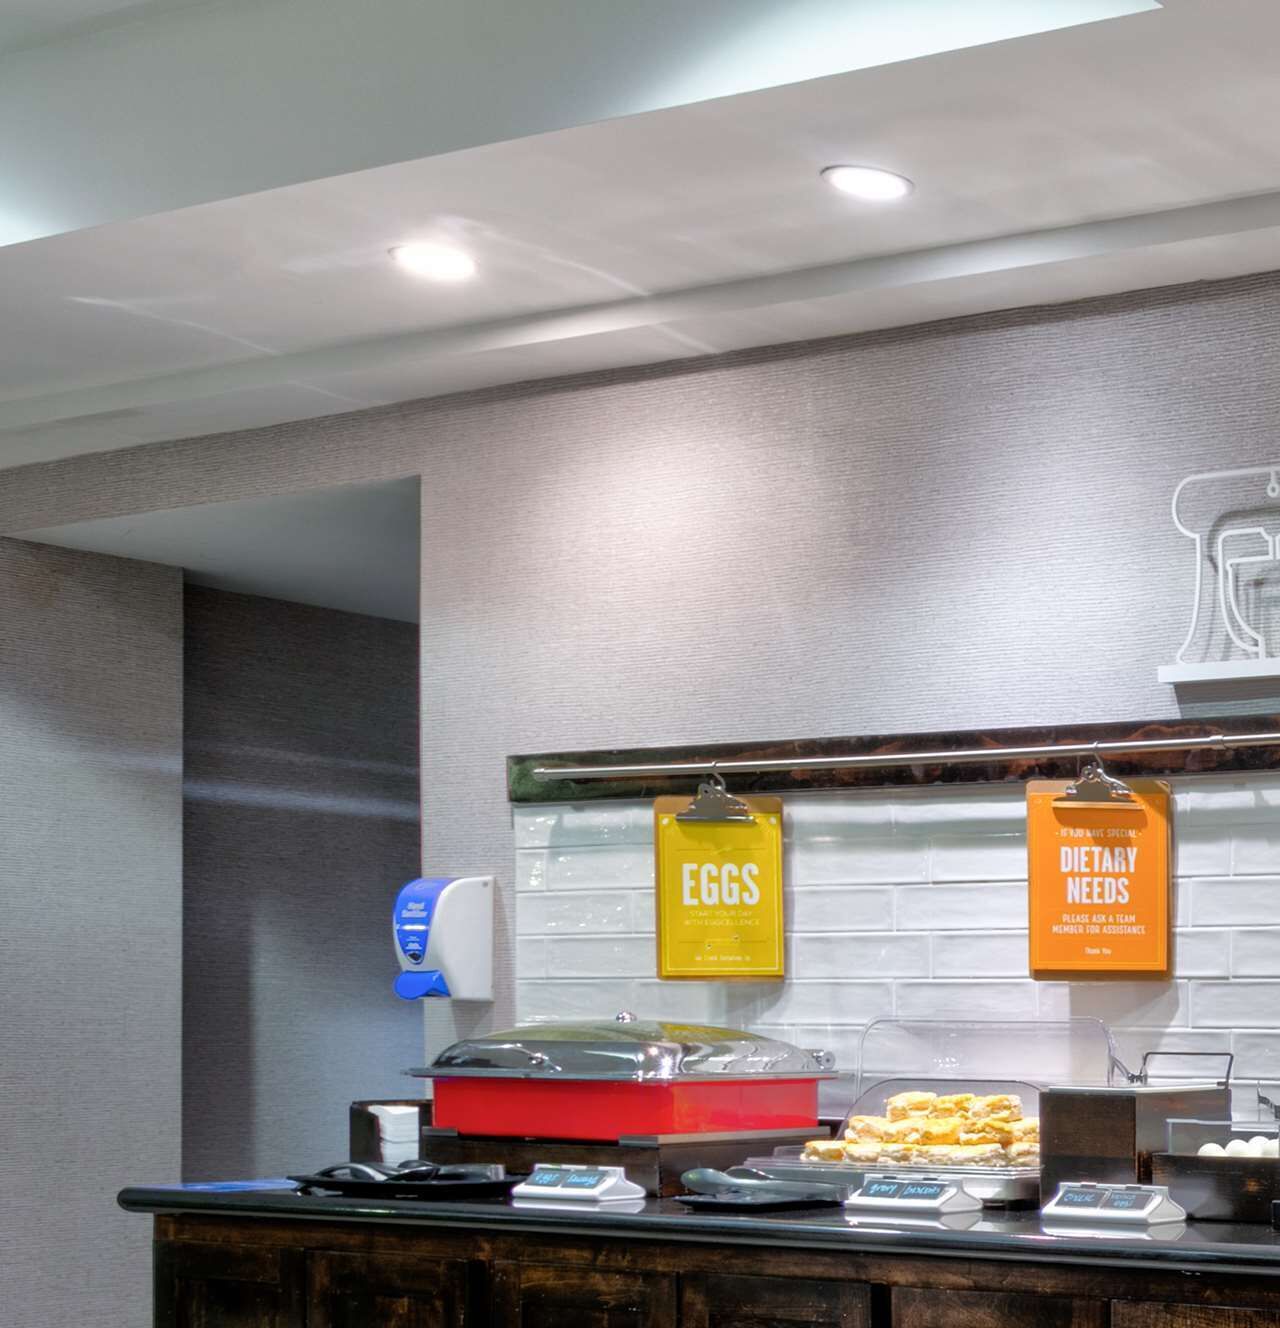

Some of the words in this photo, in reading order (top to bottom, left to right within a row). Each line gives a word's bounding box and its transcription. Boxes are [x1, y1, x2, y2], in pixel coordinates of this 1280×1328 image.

[1106, 828, 1137, 838] SPECIAL
[1060, 846, 1137, 873] DIETARY
[681, 863, 760, 906] EGGS
[1067, 877, 1129, 904] NEEDS
[1062, 914, 1089, 923] PLEASE
[1092, 914, 1106, 923] ASK
[1116, 914, 1136, 923] TEAM
[1052, 925, 1084, 934] MEMBER
[1086, 925, 1100, 934] FOR
[1102, 925, 1146, 935] ASSISTANCE
